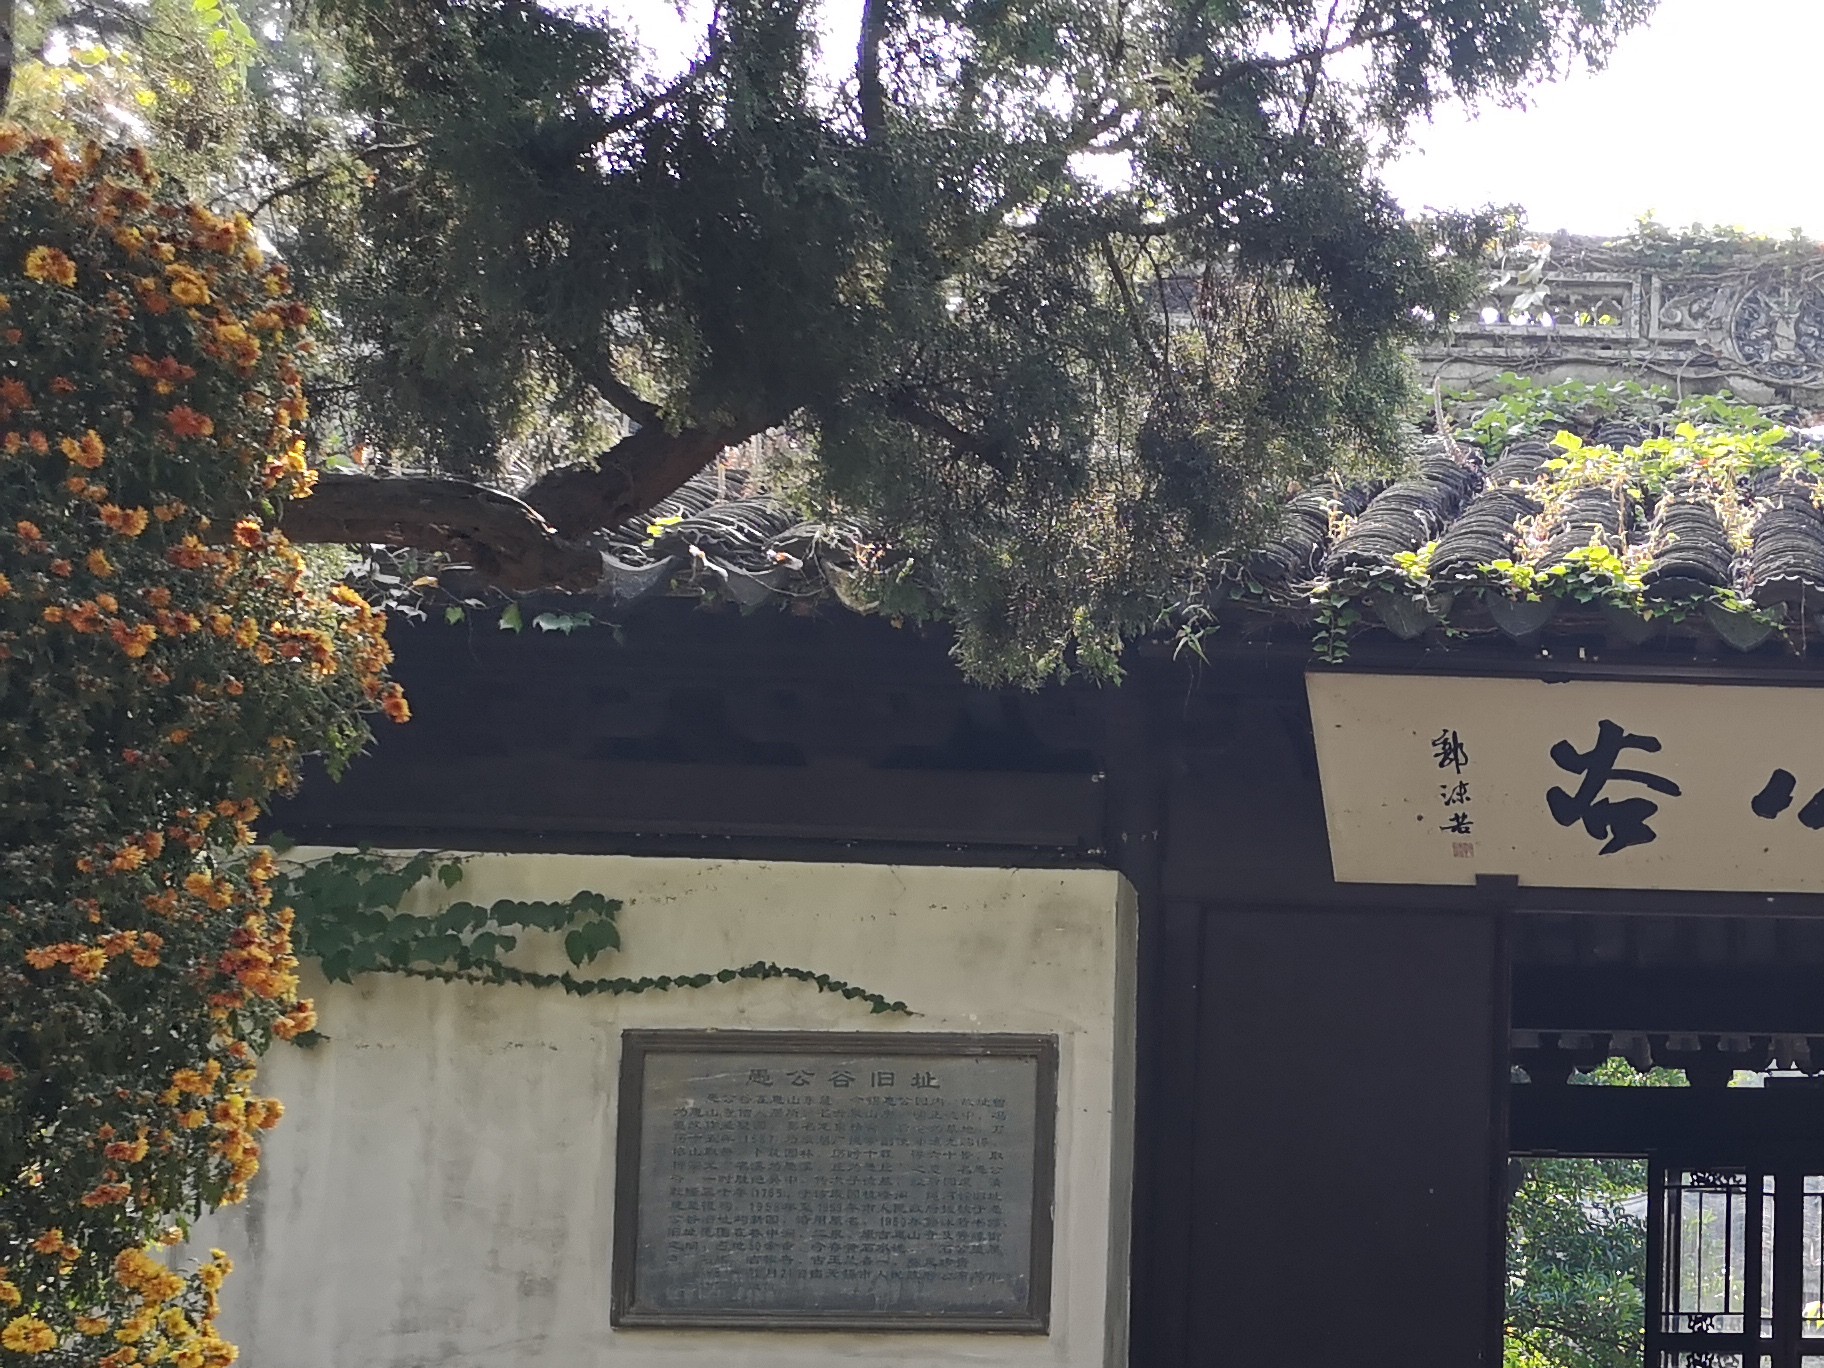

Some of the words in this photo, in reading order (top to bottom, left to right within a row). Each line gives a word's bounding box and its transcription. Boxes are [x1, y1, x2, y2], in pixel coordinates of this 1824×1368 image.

[745, 1068, 942, 1090] 愚公谷旧址
